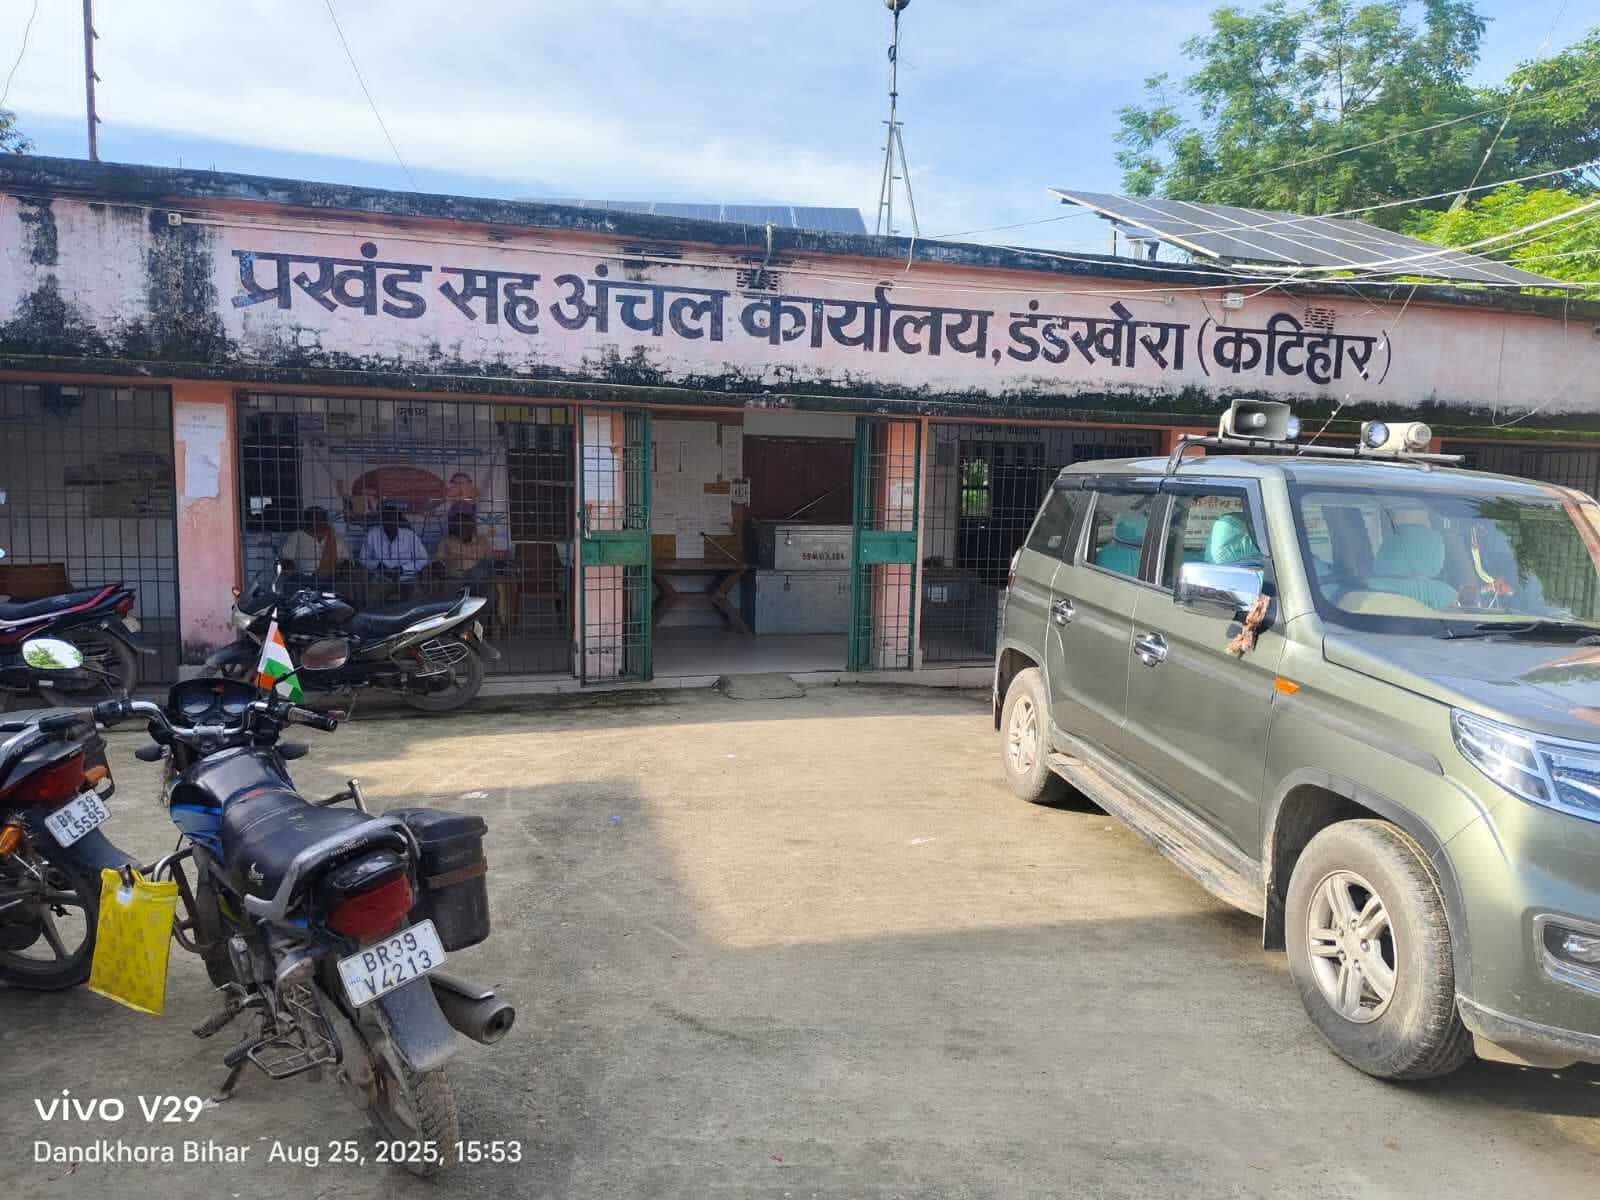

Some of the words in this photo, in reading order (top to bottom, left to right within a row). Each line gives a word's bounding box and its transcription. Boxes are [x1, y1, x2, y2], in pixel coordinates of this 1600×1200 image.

[232, 242, 432, 319] प्रखंड
[439, 266, 541, 334] सह
[550, 264, 730, 341] अंचल
[56, 810, 75, 828] BR
[362, 932, 418, 972] BR39
[364, 950, 432, 995] V4213
